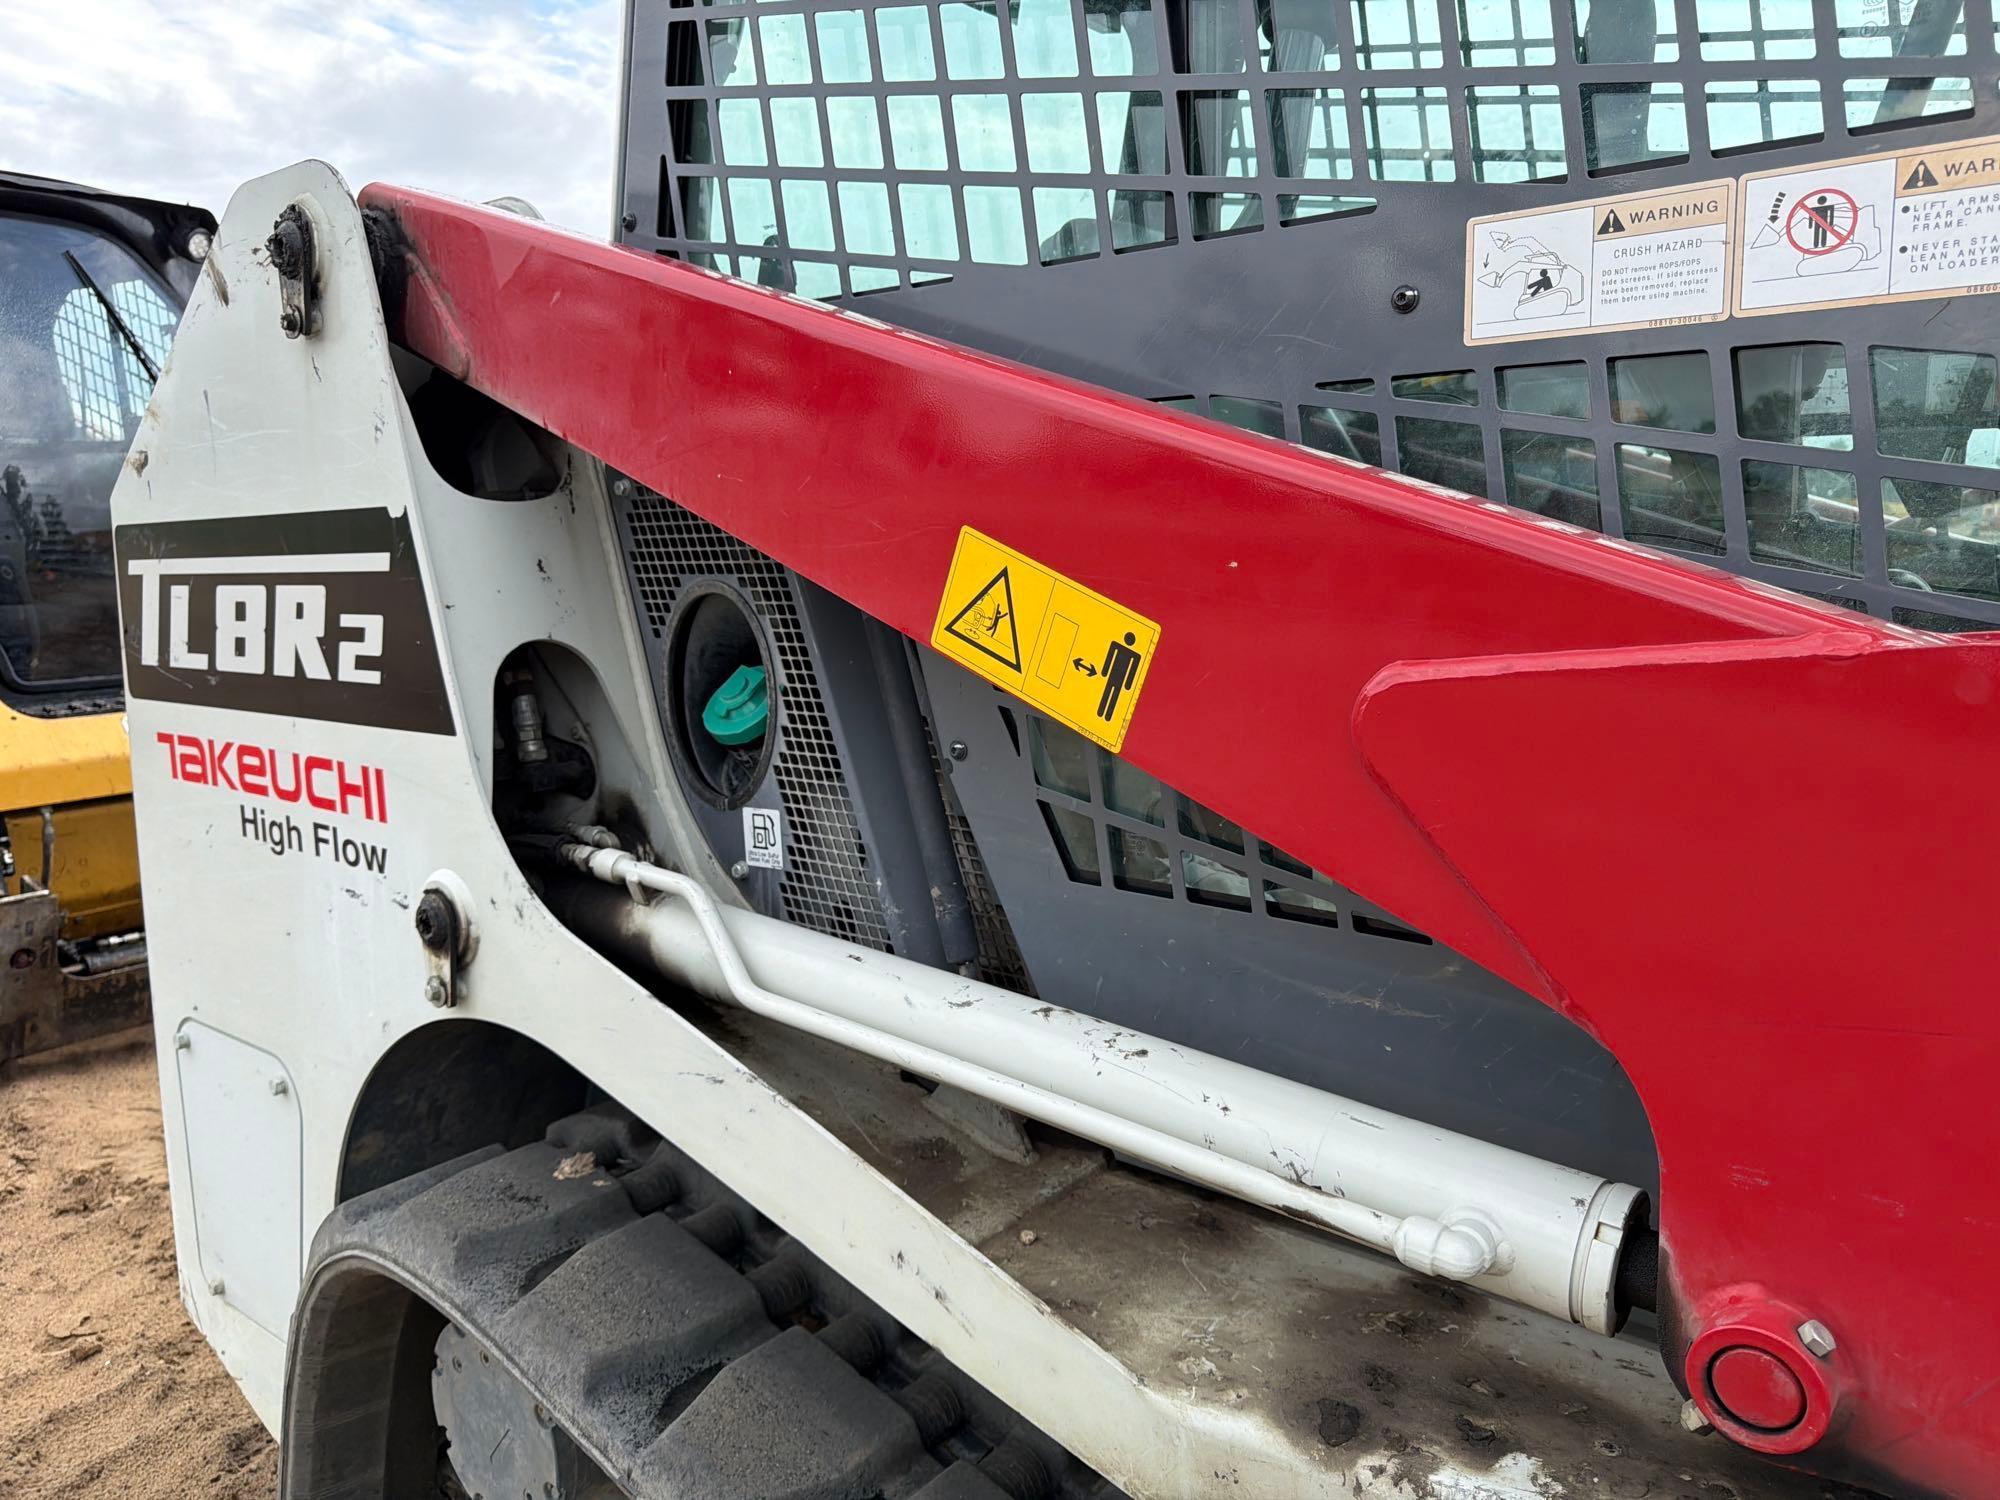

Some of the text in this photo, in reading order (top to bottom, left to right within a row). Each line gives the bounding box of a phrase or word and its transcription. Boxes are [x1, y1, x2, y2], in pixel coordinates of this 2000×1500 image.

[1944, 158, 2000, 177] WAR
[1629, 200, 1718, 224] WARNING
[1913, 193, 2000, 212] LIFT ARMS
[1913, 204, 2000, 222] NEAR CAN
[1912, 218, 1968, 232] FRAME.
[1614, 238, 1702, 258] CRUSH HAZARD
[1911, 240, 1960, 252] NEVER
[1910, 256, 1999, 273] ON LOADER
[1911, 251, 1948, 263] LEAN
[1602, 258, 1701, 277] DO NOT remove ROPS/FOPS
[1602, 278, 1617, 286] side
[1686, 266, 1718, 276] screens
[1680, 278, 1708, 287] replace
[1649, 291, 1670, 300] using
[1673, 288, 1708, 297] machine.
[128, 552, 391, 685] TL8R2
[240, 804, 388, 874] High Flow
